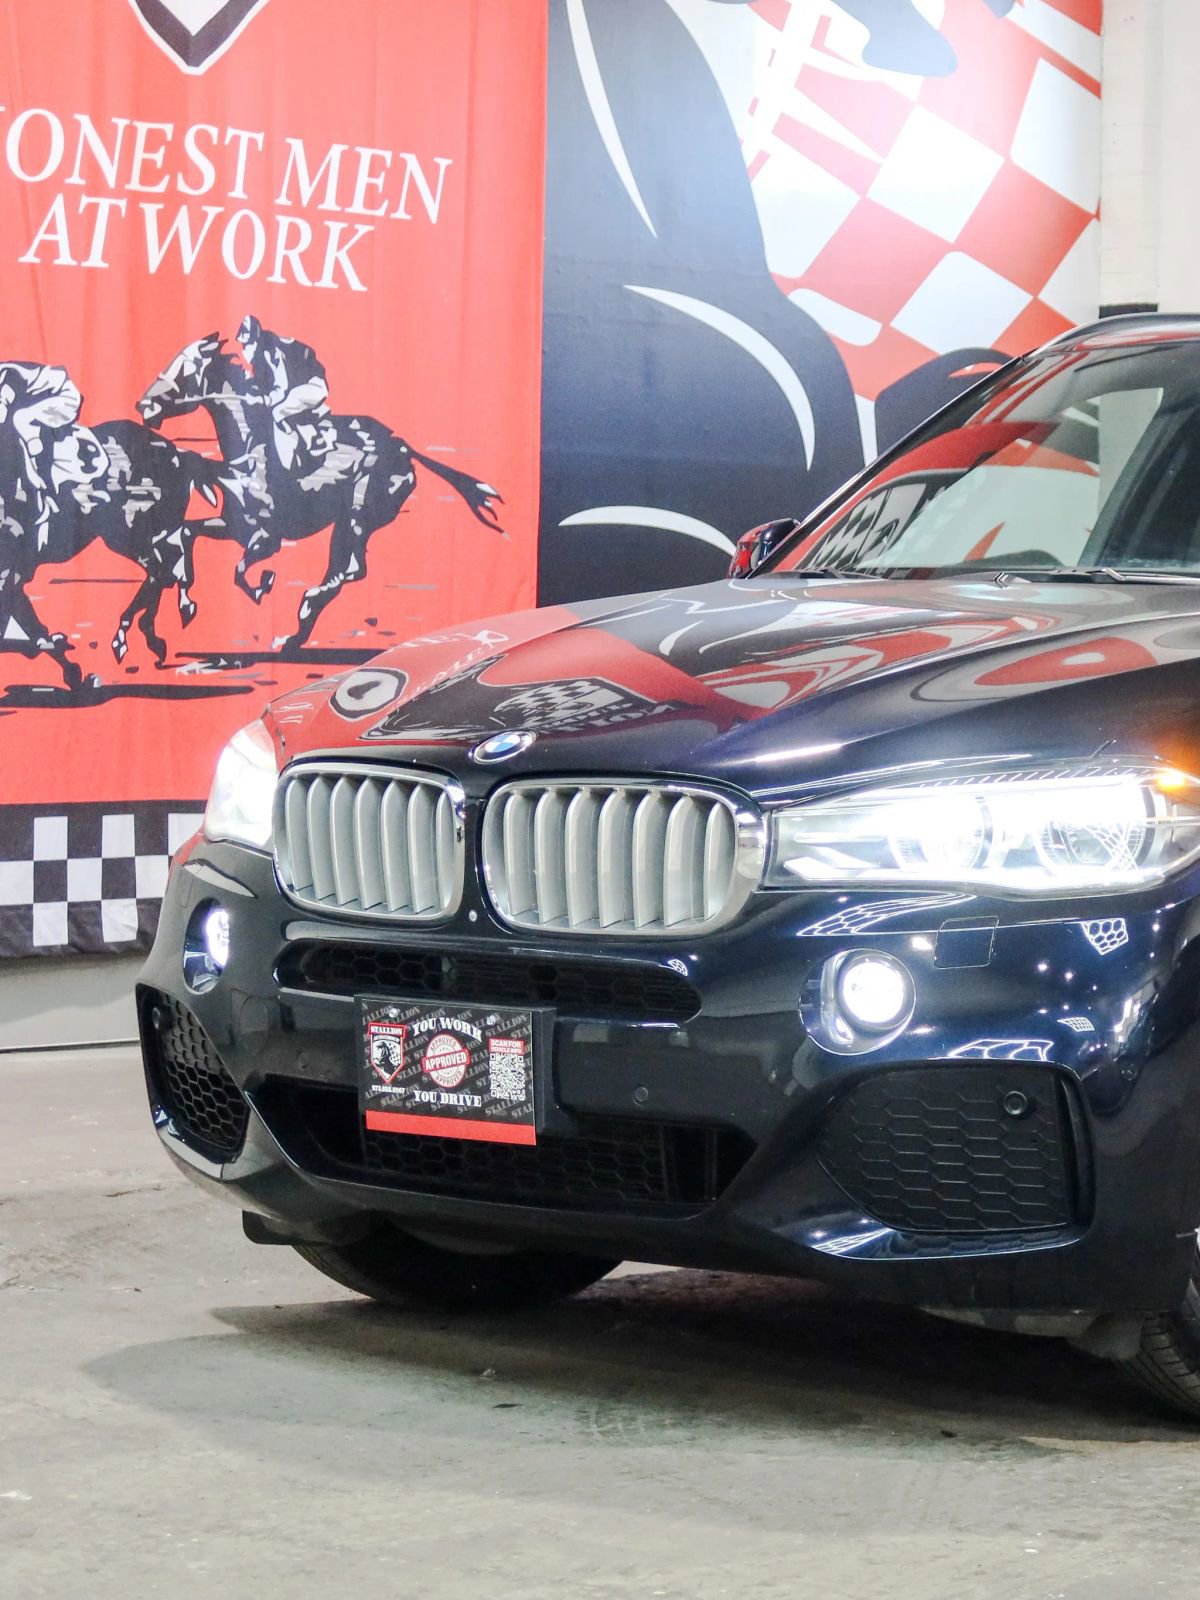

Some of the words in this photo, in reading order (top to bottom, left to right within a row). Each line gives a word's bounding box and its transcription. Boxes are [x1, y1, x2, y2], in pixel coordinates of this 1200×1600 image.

[0, 107, 264, 199] ONEST
[275, 138, 452, 224] MEN
[18, 193, 128, 268] AT
[139, 202, 375, 291] WORK
[370, 1025, 403, 1036] STALLION
[412, 1017, 437, 1037] YOU
[439, 1016, 482, 1043] WORK
[491, 1039, 508, 1048] SCAN
[509, 1041, 522, 1050] FOR
[425, 1052, 467, 1071] APPROVED
[413, 1090, 437, 1103] YOU
[440, 1092, 482, 1107] DRIVE
